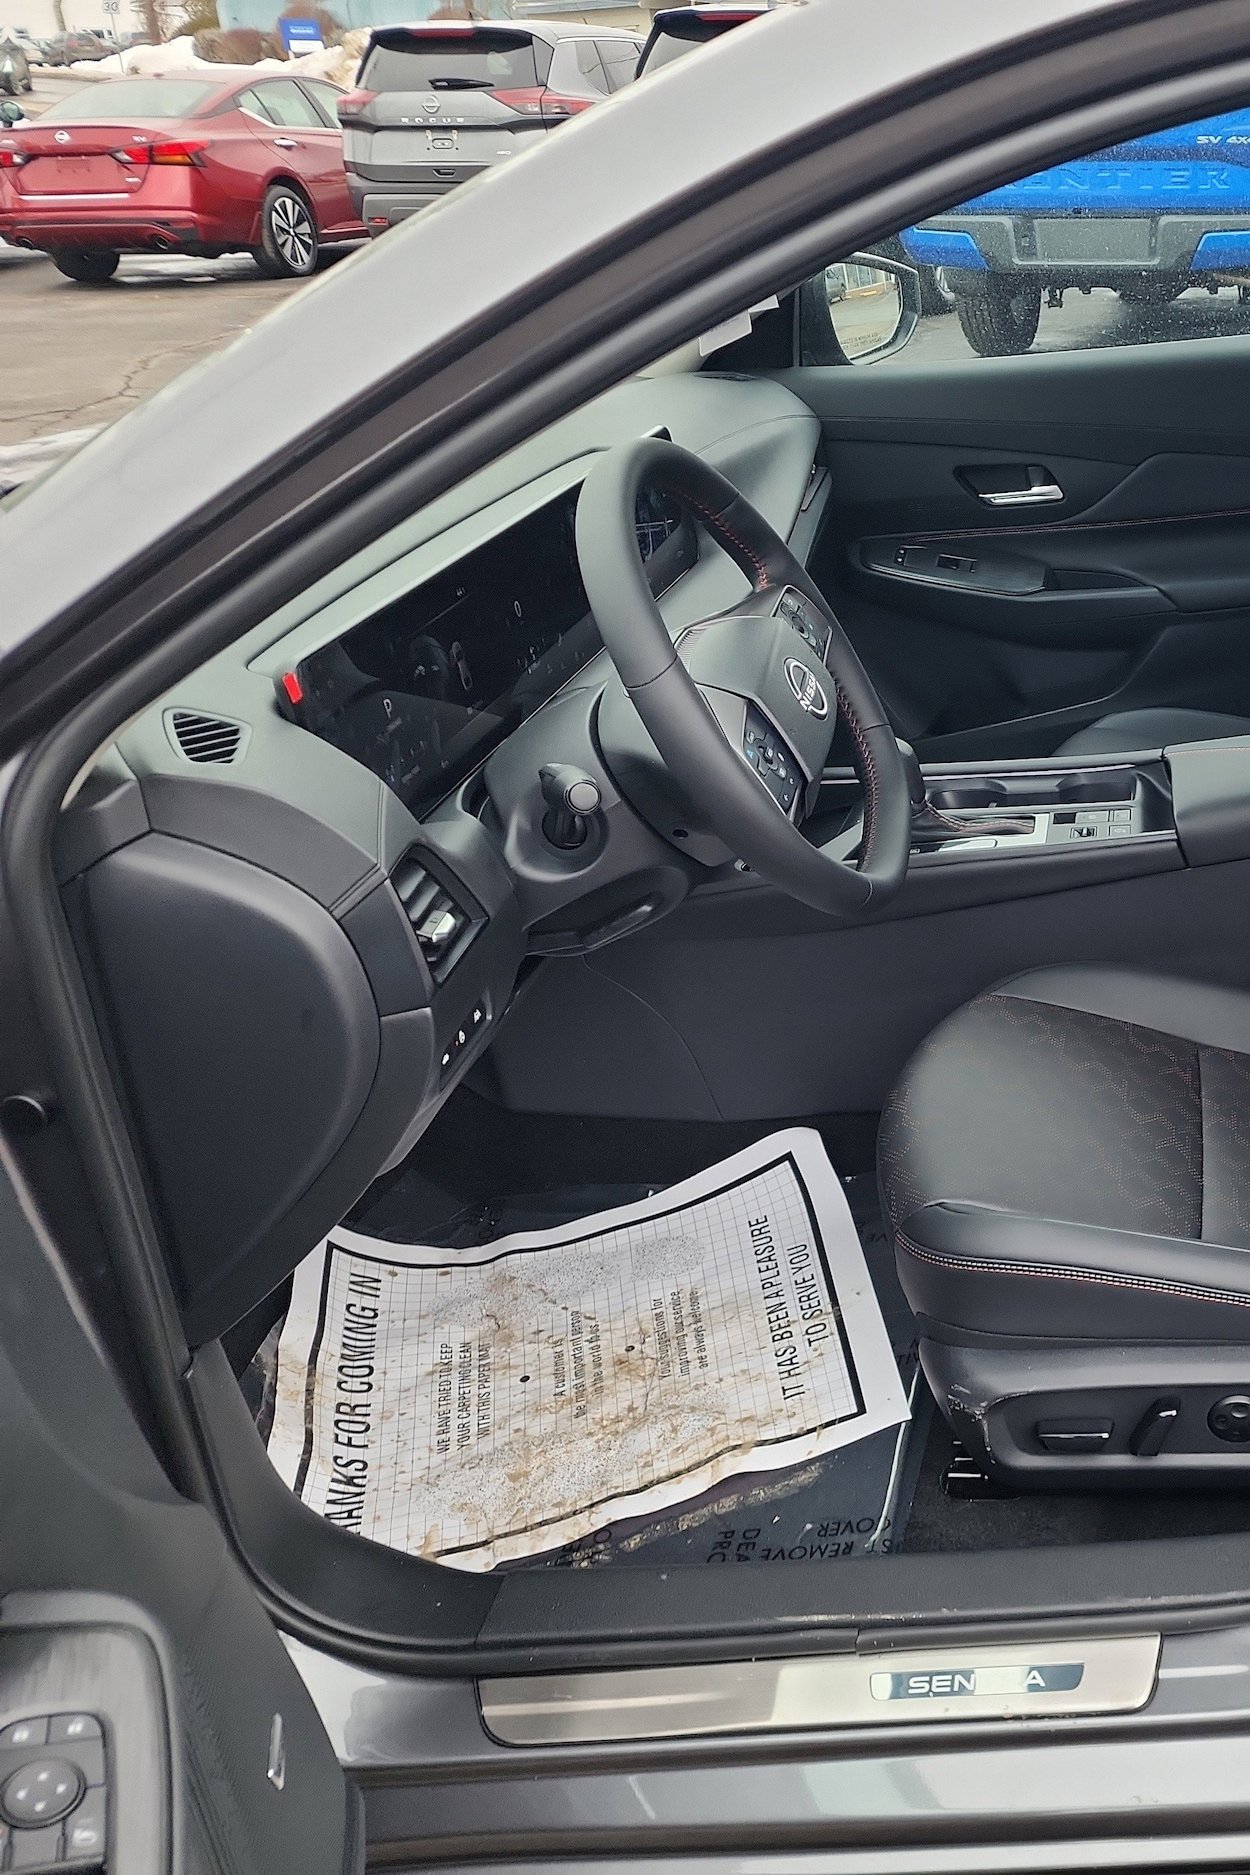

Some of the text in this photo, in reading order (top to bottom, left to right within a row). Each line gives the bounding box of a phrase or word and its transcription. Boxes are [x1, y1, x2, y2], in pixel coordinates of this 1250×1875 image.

[1196, 135, 1222, 144] SV
[799, 673, 818, 712] NISSA
[382, 698, 392, 719] P
[651, 1298, 664, 1311] for
[748, 1214, 806, 1400] IT HAS BEEN A PLEASURE
[787, 1243, 829, 1347] TO SERVE YOU
[655, 1311, 672, 1360] suggestions
[692, 1326, 707, 1354] always
[553, 1349, 566, 1387] customer
[570, 1337, 586, 1382] important
[588, 1344, 602, 1370] world
[676, 1334, 692, 1378] improving
[697, 1355, 709, 1369] are
[478, 1363, 491, 1390] PAPER
[591, 1370, 604, 1386] the
[324, 1273, 382, 1536] ANKS FOR COMING IN
[436, 1343, 453, 1455] WE HAVE TRIED TO KEEP
[456, 1342, 472, 1451] YOUR CARPETING CLEAN
[477, 1391, 491, 1413] THIS
[553, 1389, 566, 1397] A
[573, 1383, 585, 1403] most
[573, 1405, 586, 1419] the
[477, 1413, 491, 1440] WITH
[817, 1517, 891, 1538] COVER
[760, 1541, 854, 1561] REMOVE
[907, 1669, 1046, 1694] SENA
